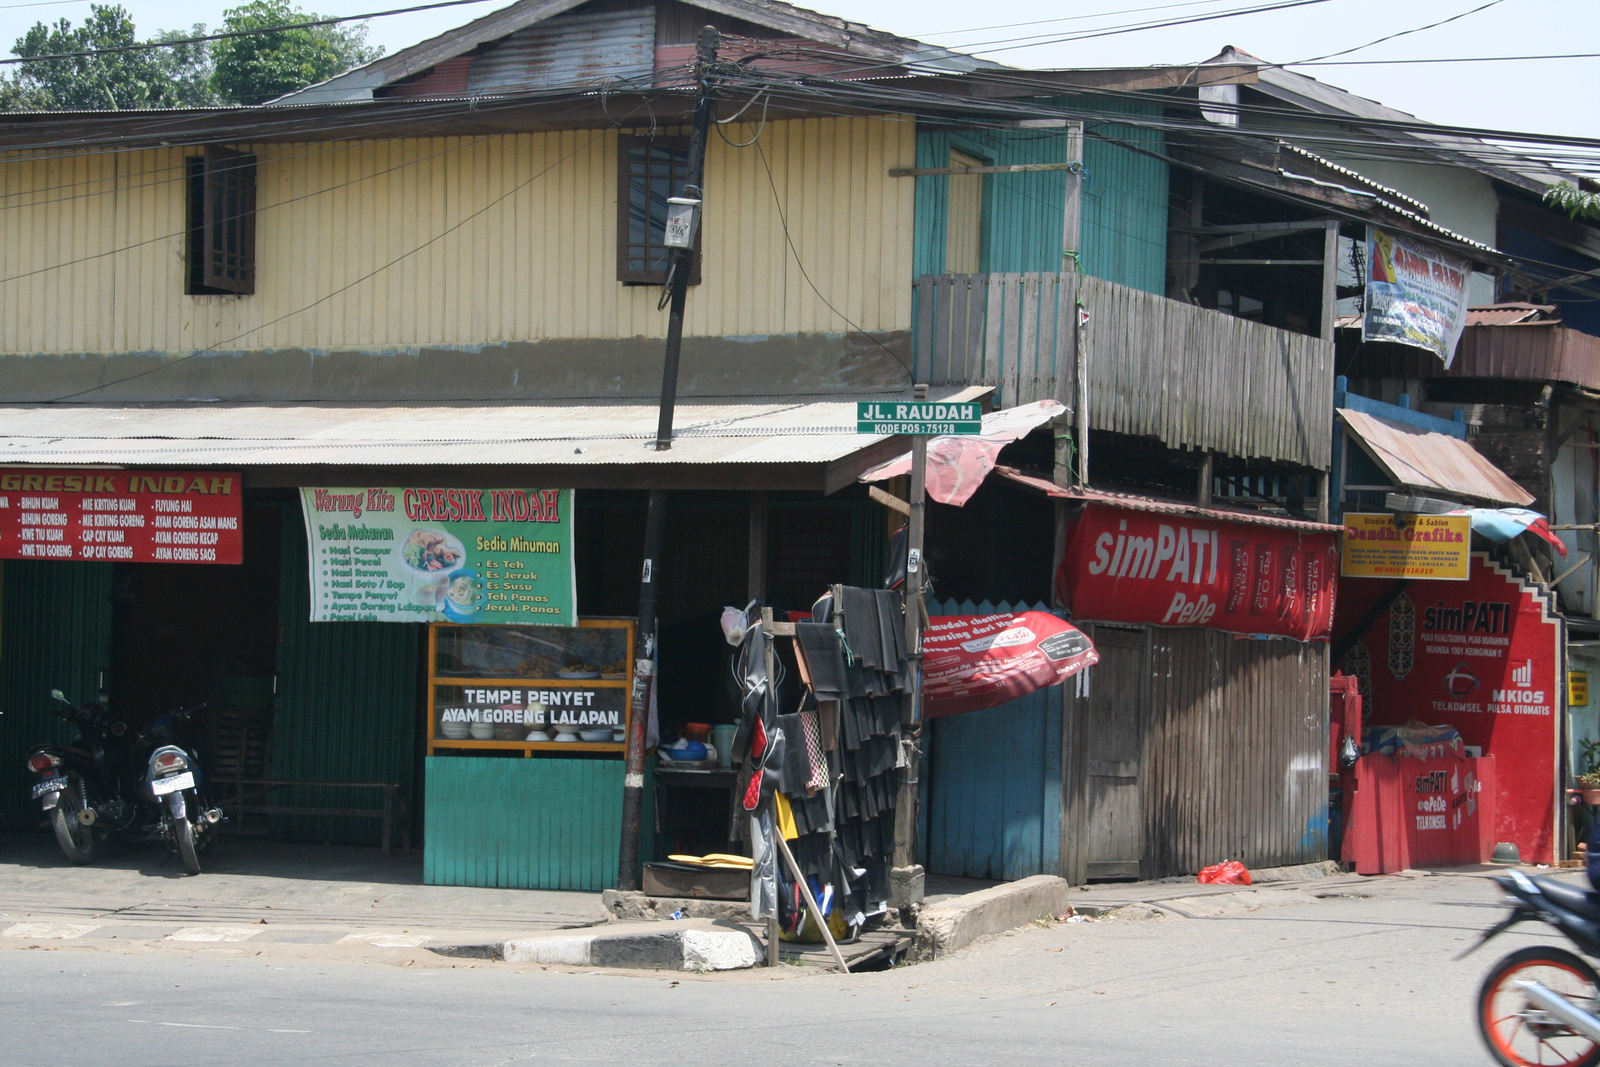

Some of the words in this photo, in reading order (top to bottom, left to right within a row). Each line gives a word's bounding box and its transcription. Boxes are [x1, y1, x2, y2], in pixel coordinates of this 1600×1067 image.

[863, 404, 891, 419] JL.
[896, 405, 973, 420] RAUDAH
[874, 424, 899, 433] KODE
[901, 424, 919, 433] POS
[926, 424, 955, 433] 75128
[0, 475, 116, 493] GRESIK
[128, 476, 232, 495] INDAH
[21, 497, 41, 509] BIHUN
[42, 498, 59, 510] KUAH
[82, 498, 93, 511] MIE
[94, 499, 118, 511] KRITING
[119, 499, 136, 511] KUAH
[155, 500, 180, 512] FUYUNG
[181, 500, 192, 512] HAI
[314, 489, 363, 518] Warung
[366, 488, 395, 512] Kita
[403, 488, 485, 521] GRESIK
[491, 489, 560, 522] INDAH
[21, 513, 41, 525] BIHUN
[42, 513, 68, 526] GORENG
[82, 514, 93, 527] MIE
[94, 514, 118, 527] KRITING
[119, 515, 145, 527] GORENG
[155, 516, 172, 528] AYAM
[172, 516, 199, 528] GORENG
[199, 517, 217, 529] ASAM
[217, 517, 238, 530] MANIS
[1364, 517, 1385, 525] Studio
[1426, 518, 1448, 526] Sablon
[21, 528, 35, 541] KWE
[35, 529, 45, 541] TIU
[46, 529, 64, 541] KUAH
[82, 530, 94, 542] CAP
[95, 530, 106, 542] CAY
[107, 530, 125, 542] KUAH
[155, 531, 172, 543] AYAM
[172, 532, 199, 544] GORENG
[199, 532, 219, 545] KECAP
[319, 523, 346, 540] Sedia
[347, 524, 394, 540] Makanan
[1347, 527, 1401, 541] Dandhi
[1404, 527, 1463, 542] Grafika
[22, 544, 35, 556] KWE
[36, 544, 46, 556] TIU
[46, 544, 73, 557] GORENG
[476, 535, 507, 551] Sedia
[510, 536, 560, 553] Minuman
[82, 546, 94, 558] CAP
[95, 546, 107, 558] CAY
[107, 546, 133, 558] GORENG
[155, 547, 172, 559] AYAM
[173, 547, 199, 560] GORENG
[200, 548, 216, 560] SAOS
[329, 546, 350, 555] Nasi
[353, 546, 391, 557] Campur
[1088, 519, 1218, 585] simPATI
[330, 557, 351, 566] Nasi
[354, 557, 382, 566] Pecel
[486, 560, 499, 568] Es
[503, 560, 524, 569] Teh
[330, 568, 352, 577] Nasi
[354, 568, 388, 577] Rawon
[486, 571, 499, 579] Es
[503, 571, 537, 580] Jeruk
[331, 579, 353, 588] Nasi
[355, 579, 377, 588] Soto
[386, 580, 405, 591] Sop
[486, 581, 499, 590] Es
[503, 582, 532, 591] Susu
[331, 591, 362, 601] Tempe
[364, 591, 398, 601] Penyet
[486, 592, 507, 601] Teh
[511, 593, 549, 603] Panas
[330, 602, 358, 612] Ayam
[360, 602, 395, 613] Goreng
[397, 602, 436, 613] Lalapan
[484, 603, 519, 612] Jeruk
[522, 604, 560, 614] Panas
[1162, 591, 1216, 624] PeDe
[329, 613, 356, 621] Pecel
[930, 620, 968, 631] mudah
[970, 613, 1014, 626] chatting
[1423, 600, 1510, 633] simPATI
[923, 631, 971, 643] rowsing
[972, 625, 995, 635] dari
[1056, 662, 1081, 675] simPATI
[465, 689, 521, 704] TEMPE
[528, 690, 595, 706] PENYET
[1432, 701, 1482, 713] TELKOMSEL
[1487, 703, 1511, 714] PULSA
[1514, 705, 1550, 715] OTOMATIS
[441, 708, 479, 723] AYAM
[483, 709, 545, 724] GORENG
[550, 710, 618, 725] LALAPAN
[1415, 770, 1447, 793] simPATI
[1416, 815, 1447, 830] TELKOMSEL
